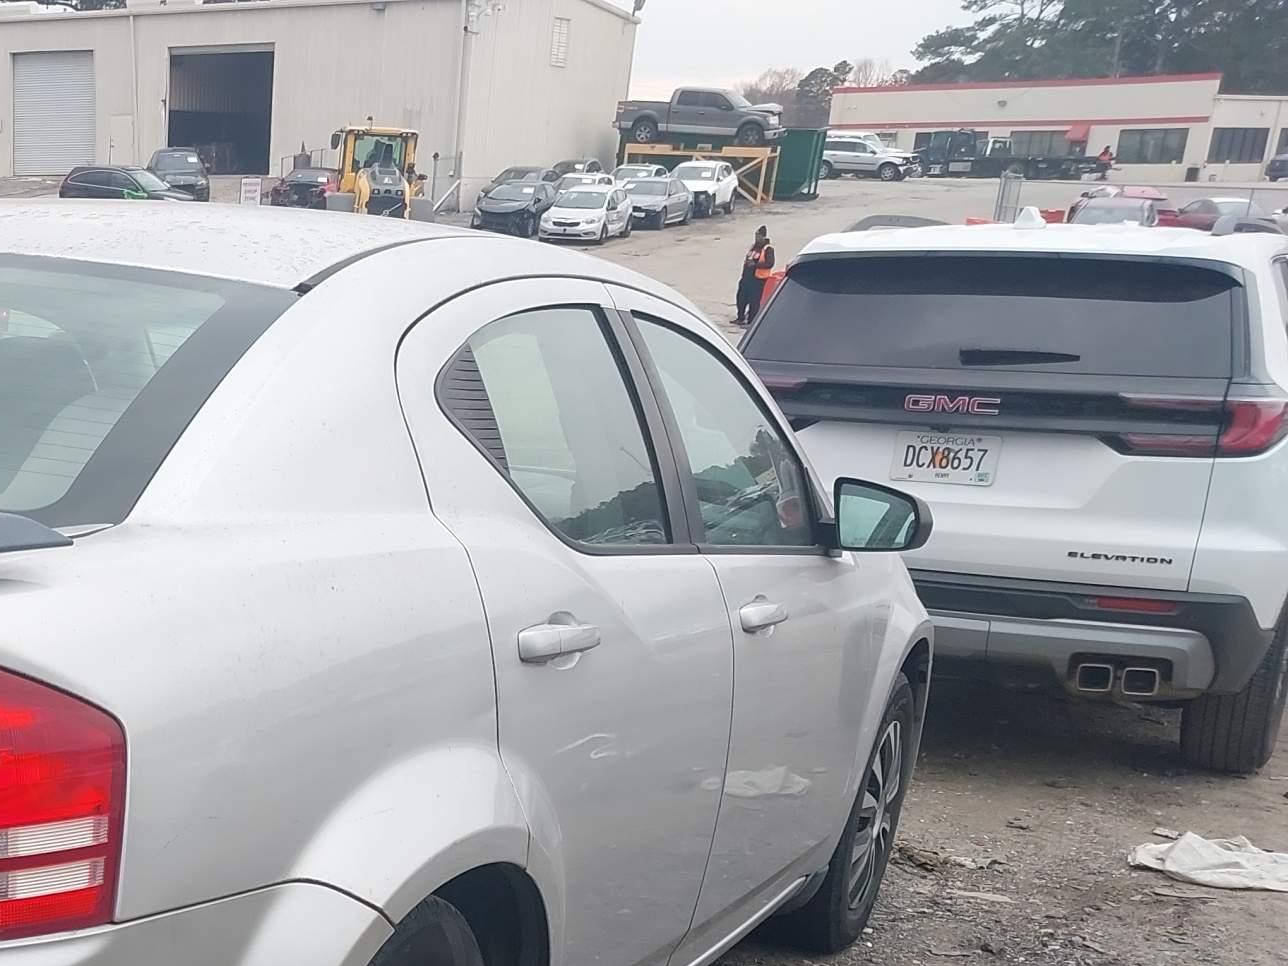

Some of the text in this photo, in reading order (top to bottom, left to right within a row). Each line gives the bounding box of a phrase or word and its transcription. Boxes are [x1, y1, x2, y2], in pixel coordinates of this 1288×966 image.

[905, 394, 1001, 416] GMC
[920, 435, 975, 446] GEORGIA
[903, 445, 989, 472] DCX8657
[1067, 551, 1172, 565] ELEVATION
